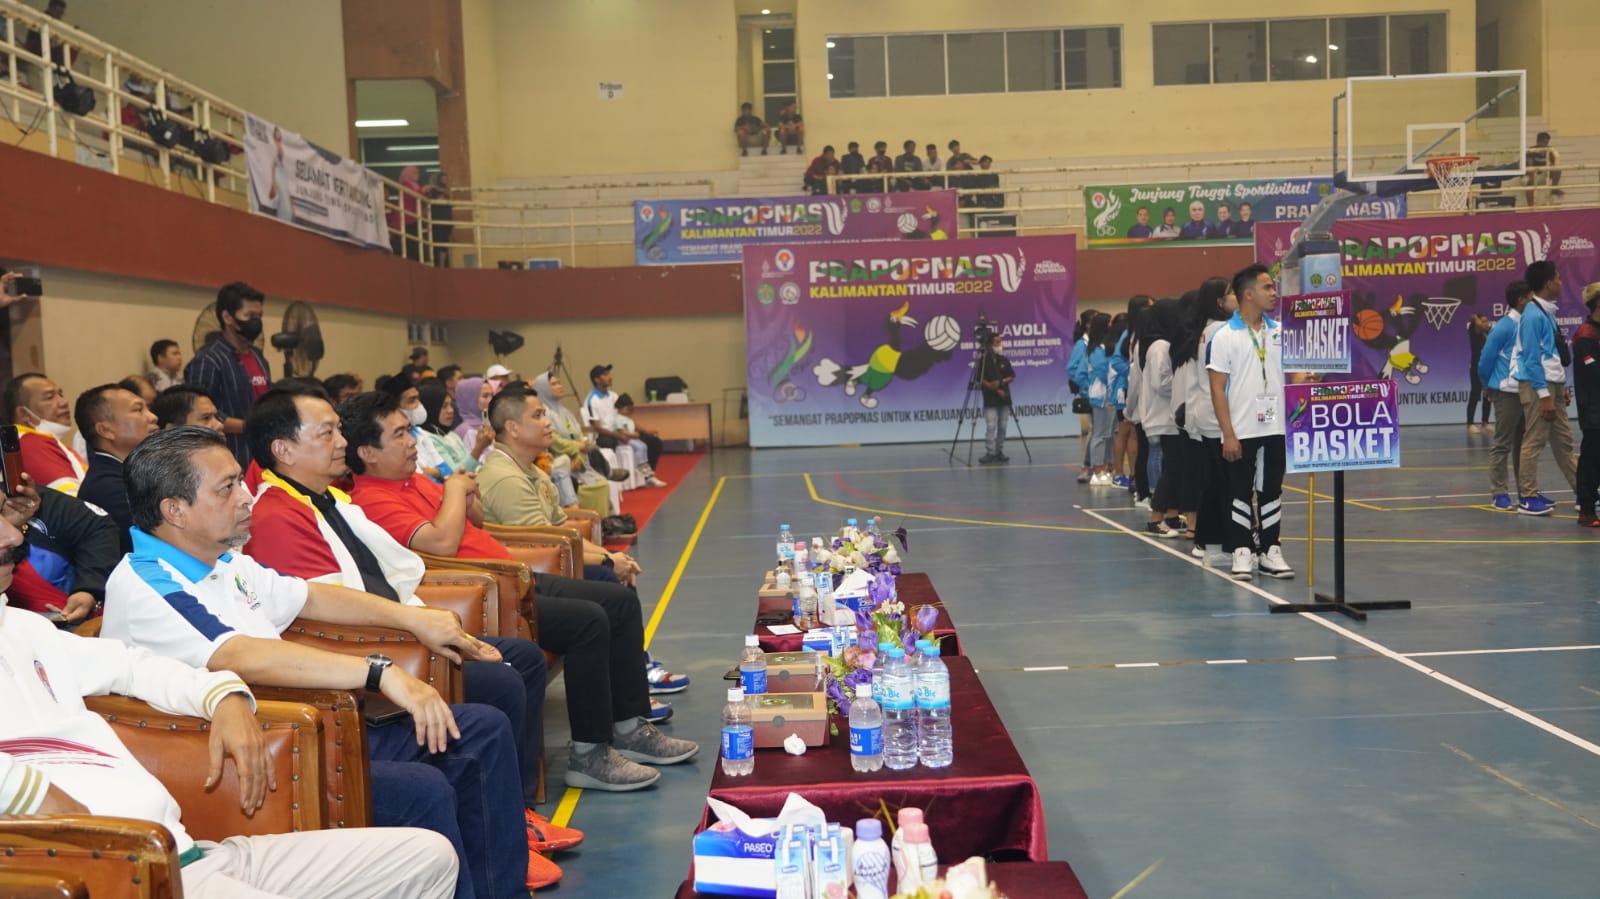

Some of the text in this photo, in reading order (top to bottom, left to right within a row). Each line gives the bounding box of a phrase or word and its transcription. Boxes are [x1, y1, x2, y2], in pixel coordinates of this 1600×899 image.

[1130, 181, 1312, 203] Junjung Tinggi Sportivitas!
[680, 204, 823, 227] PRAPOPNAS
[1275, 202, 1382, 219] PRANAS
[809, 254, 993, 283] PRAPOPNAS
[809, 280, 993, 299] KALIMANTANTIMUR2022
[1283, 317, 1349, 360] BOLA BASKET
[1310, 383, 1379, 396] PRAPOPNAS
[1430, 391, 1469, 405] KEMAJU
[824, 411, 879, 425] PRAPOPNAS
[880, 410, 913, 424] UNTUK
[1311, 401, 1393, 429] BOLA
[1293, 427, 1394, 463] BASKET
[744, 842, 773, 853] PASEO
